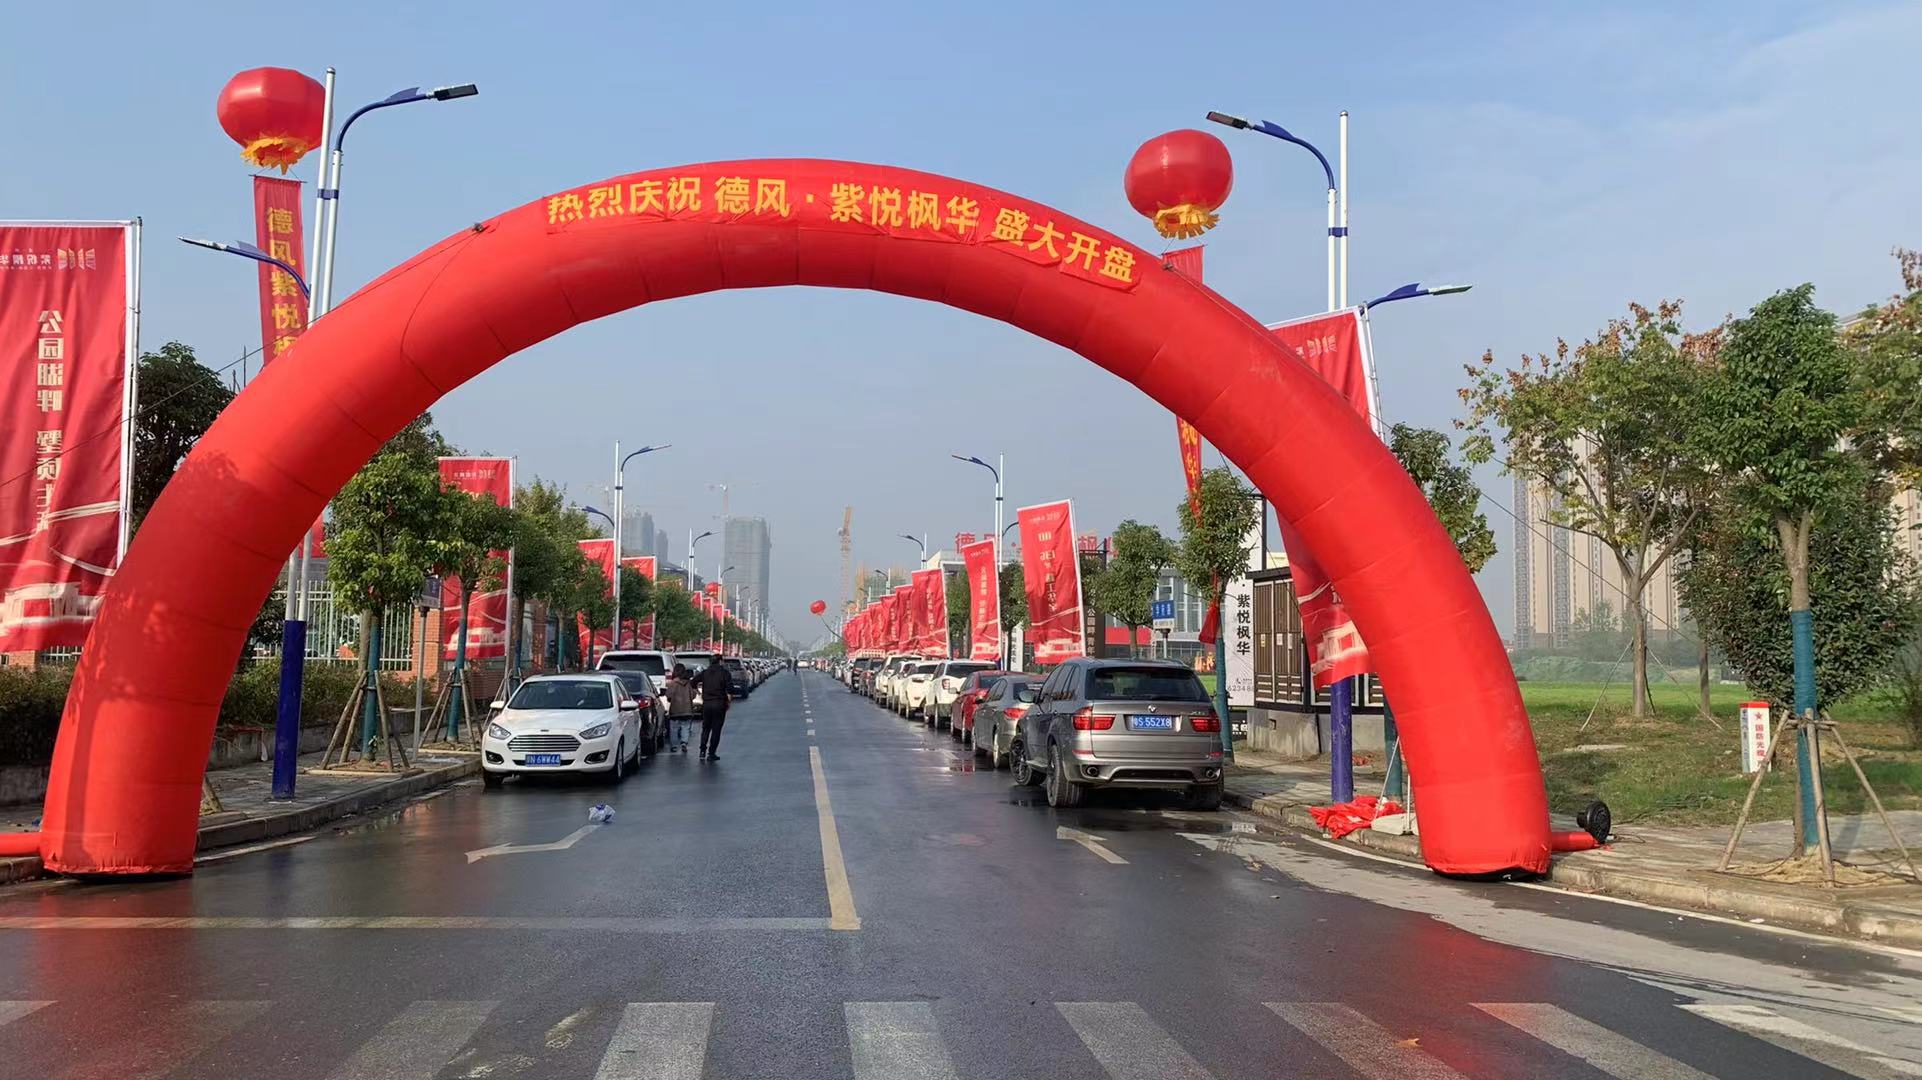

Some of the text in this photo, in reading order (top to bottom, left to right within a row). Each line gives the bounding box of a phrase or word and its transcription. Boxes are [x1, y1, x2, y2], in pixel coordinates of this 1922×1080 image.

[547, 176, 702, 225] 热烈庆祝
[991, 206, 1137, 284] 盛大开盘
